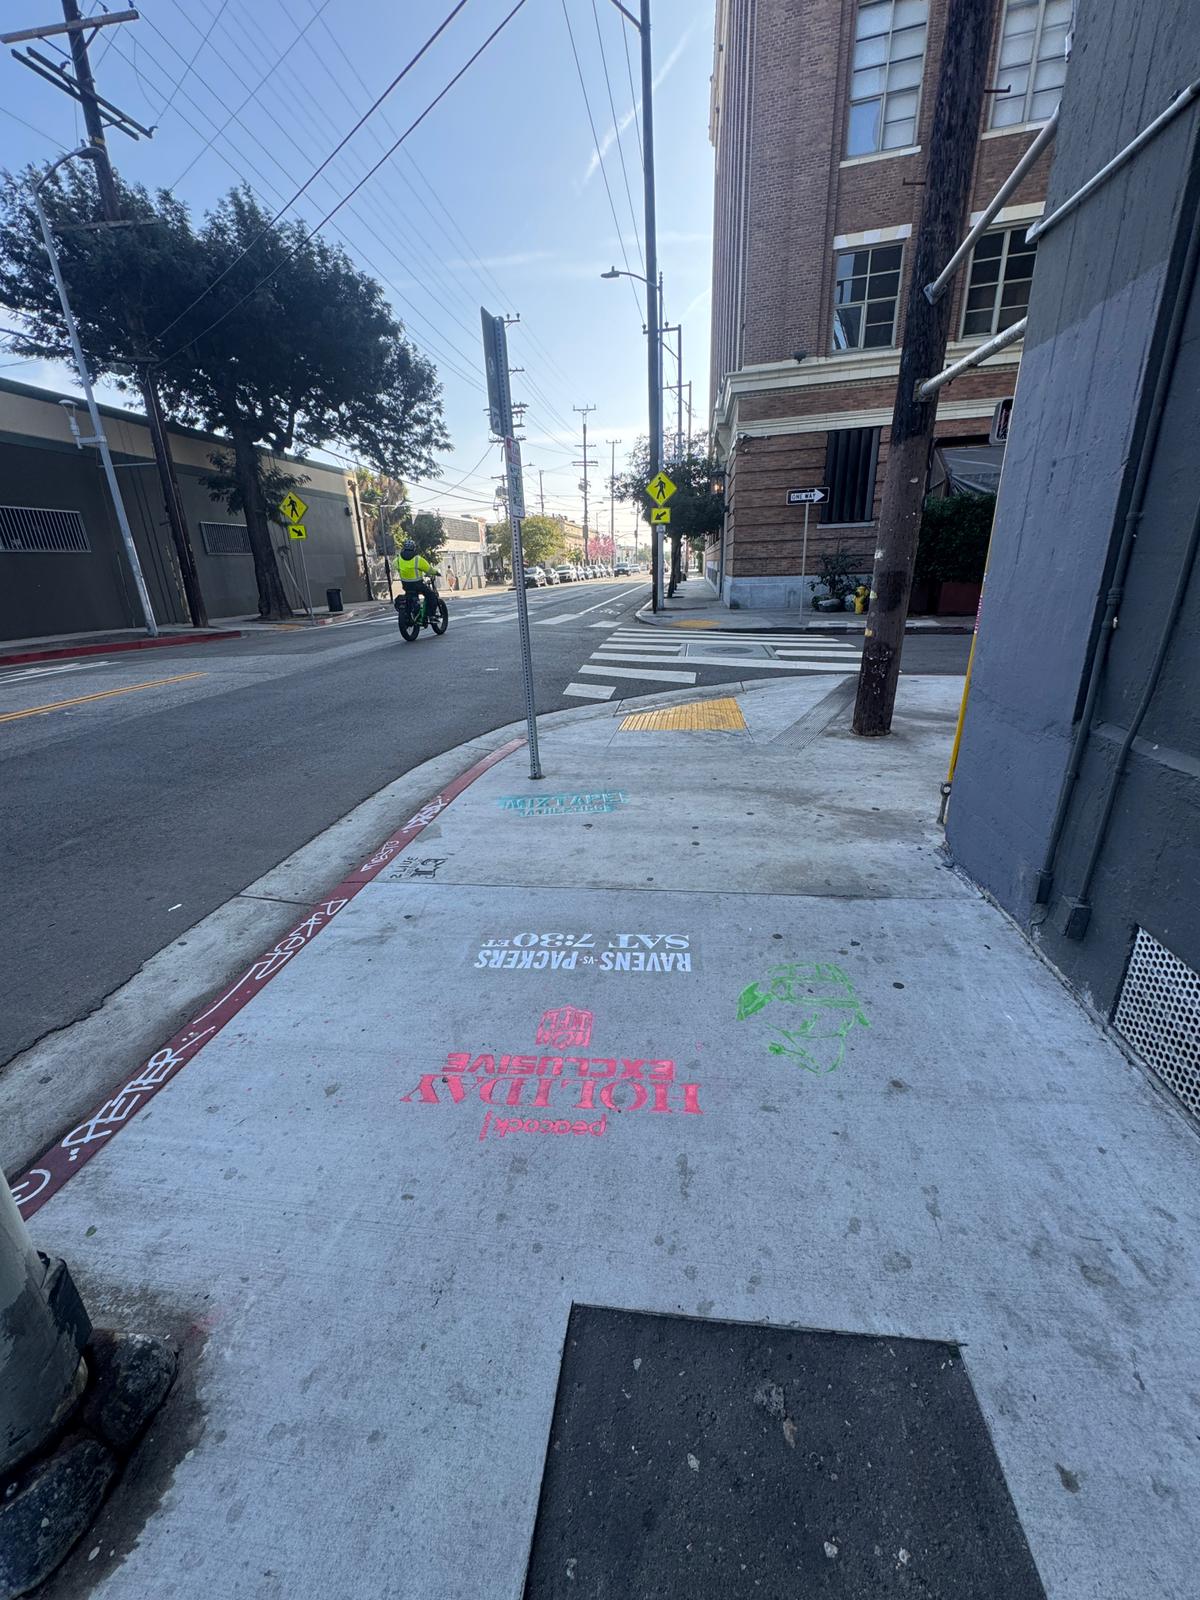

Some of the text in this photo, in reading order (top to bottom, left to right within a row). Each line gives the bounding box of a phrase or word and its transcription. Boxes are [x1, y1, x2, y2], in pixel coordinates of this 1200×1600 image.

[791, 491, 817, 501] ONE WAY
[480, 932, 690, 950] SAT 7:30 ET
[474, 949, 579, 969] PACKERS
[600, 952, 692, 972] RAVENS
[442, 1052, 675, 1081] EXCLUSIVE
[400, 1073, 704, 1115] HOLIDAY
